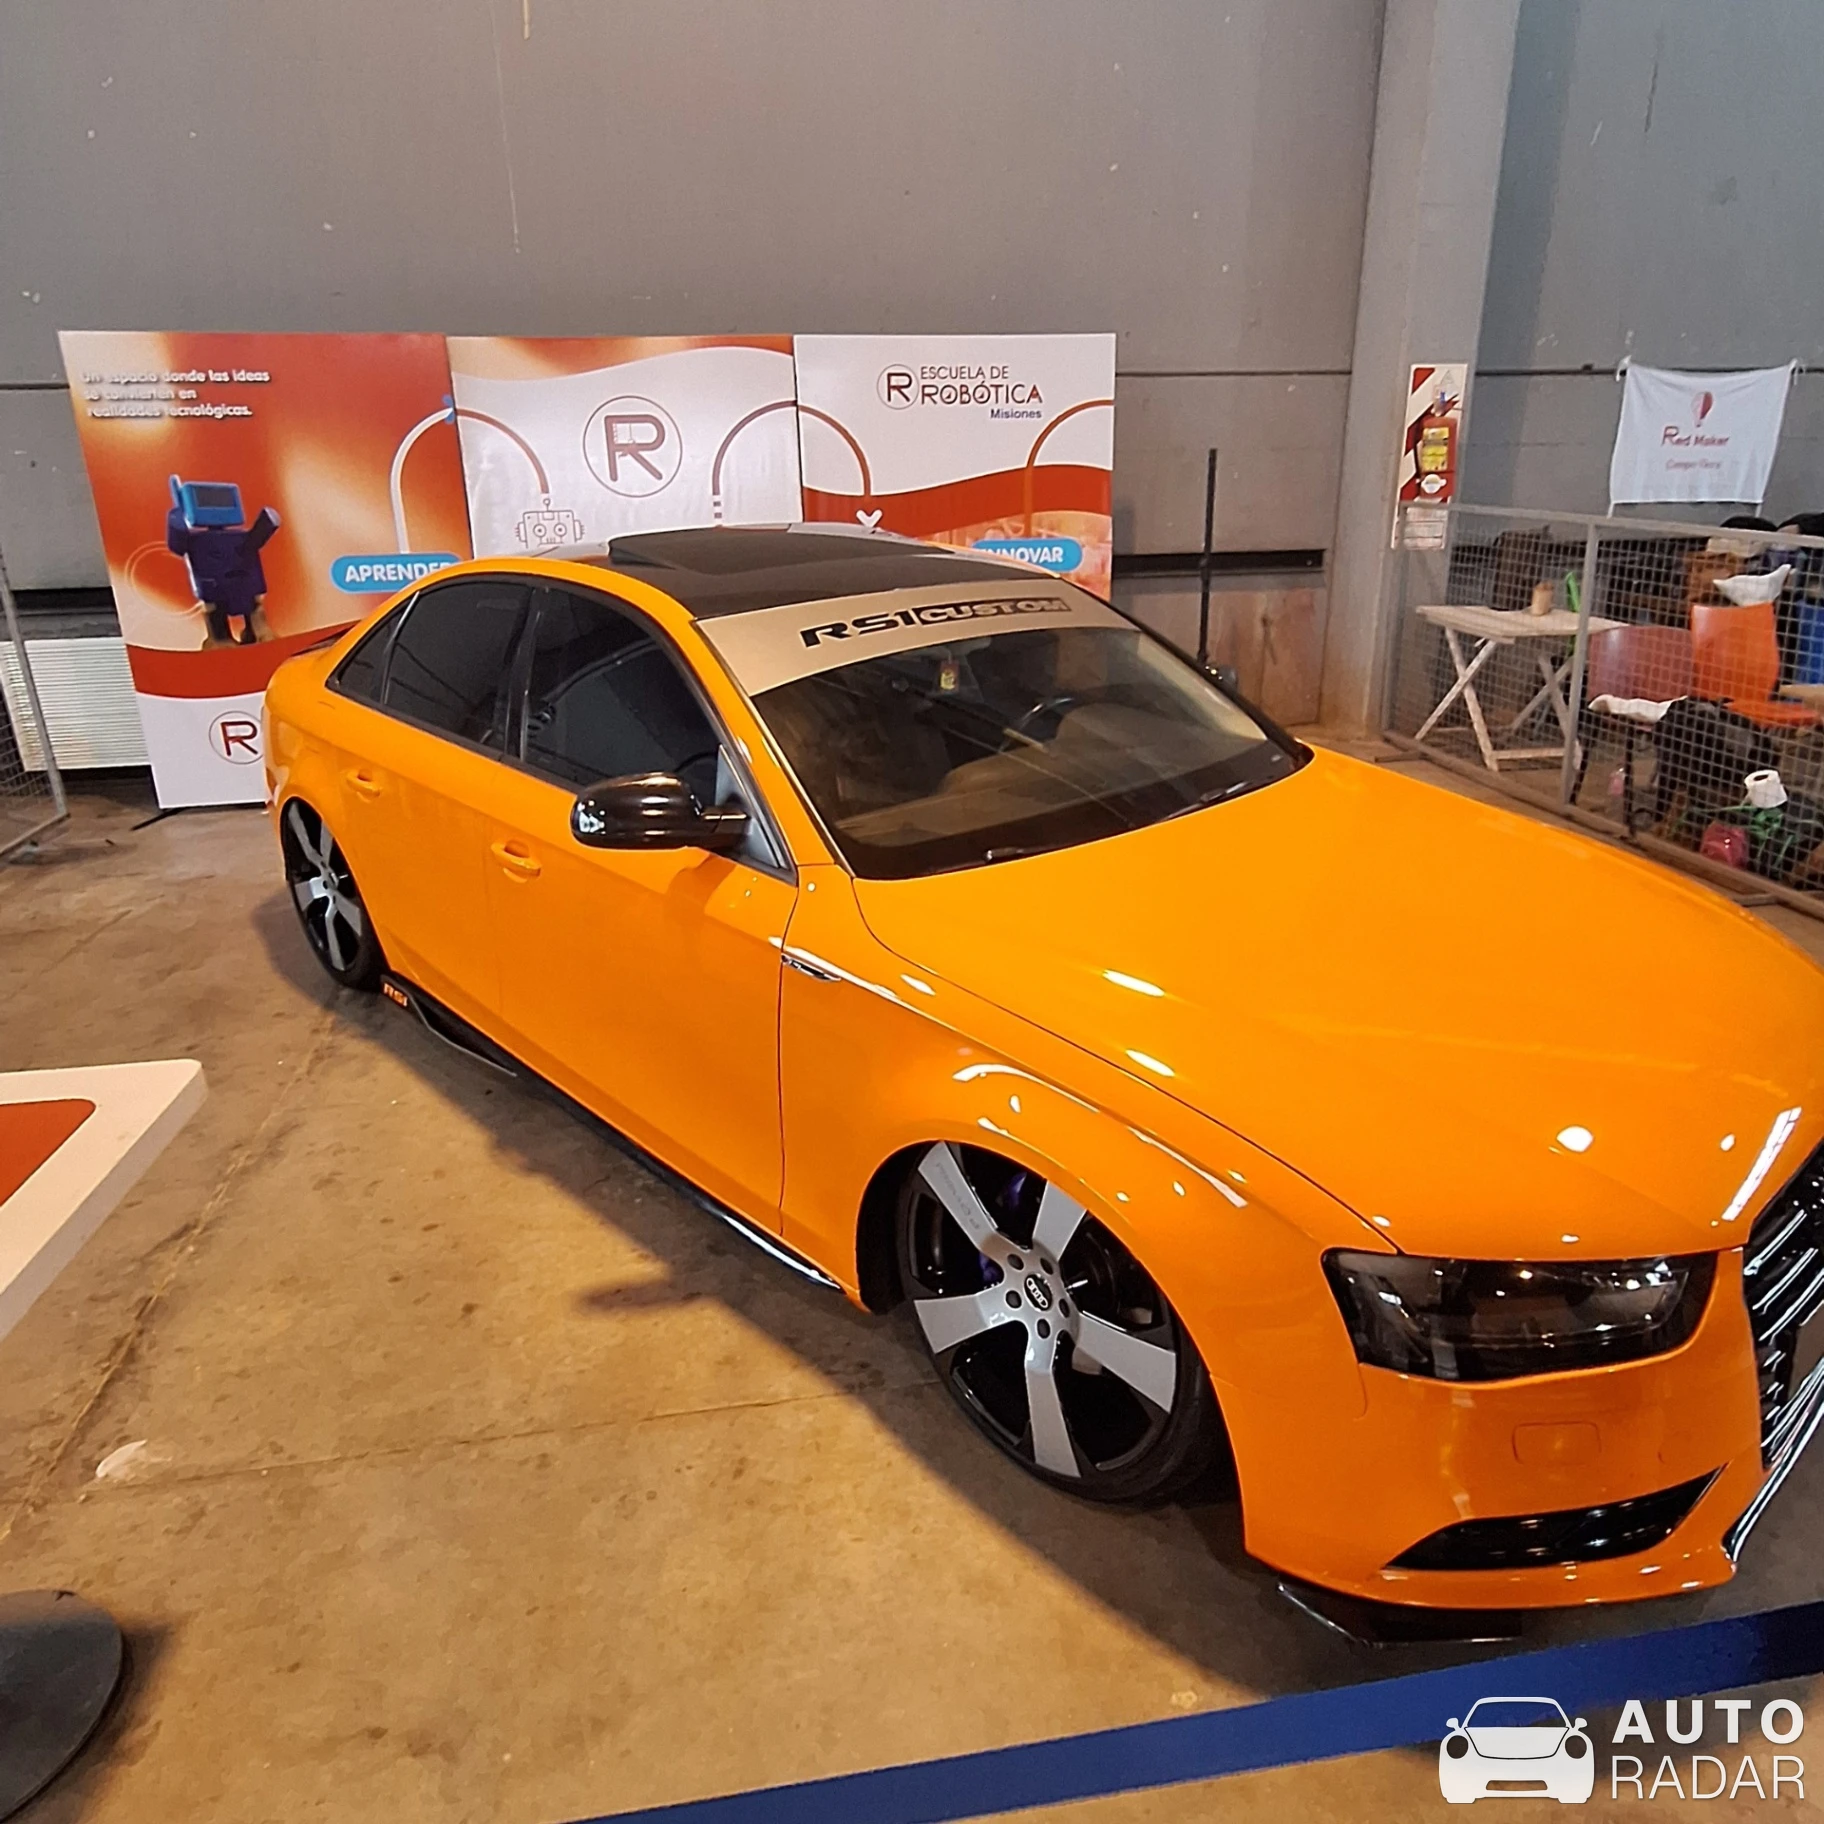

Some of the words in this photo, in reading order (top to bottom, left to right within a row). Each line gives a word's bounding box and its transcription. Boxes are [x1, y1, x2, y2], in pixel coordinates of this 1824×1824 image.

[163, 370, 206, 383] donde
[208, 369, 230, 382] las
[233, 369, 270, 382] ideas
[920, 366, 985, 380] ESCUELA
[990, 366, 1009, 379] DE
[178, 389, 198, 400] en
[921, 381, 1043, 405] ROBÓTICA
[990, 408, 1042, 420] Misiones
[1662, 425, 1691, 447] Red
